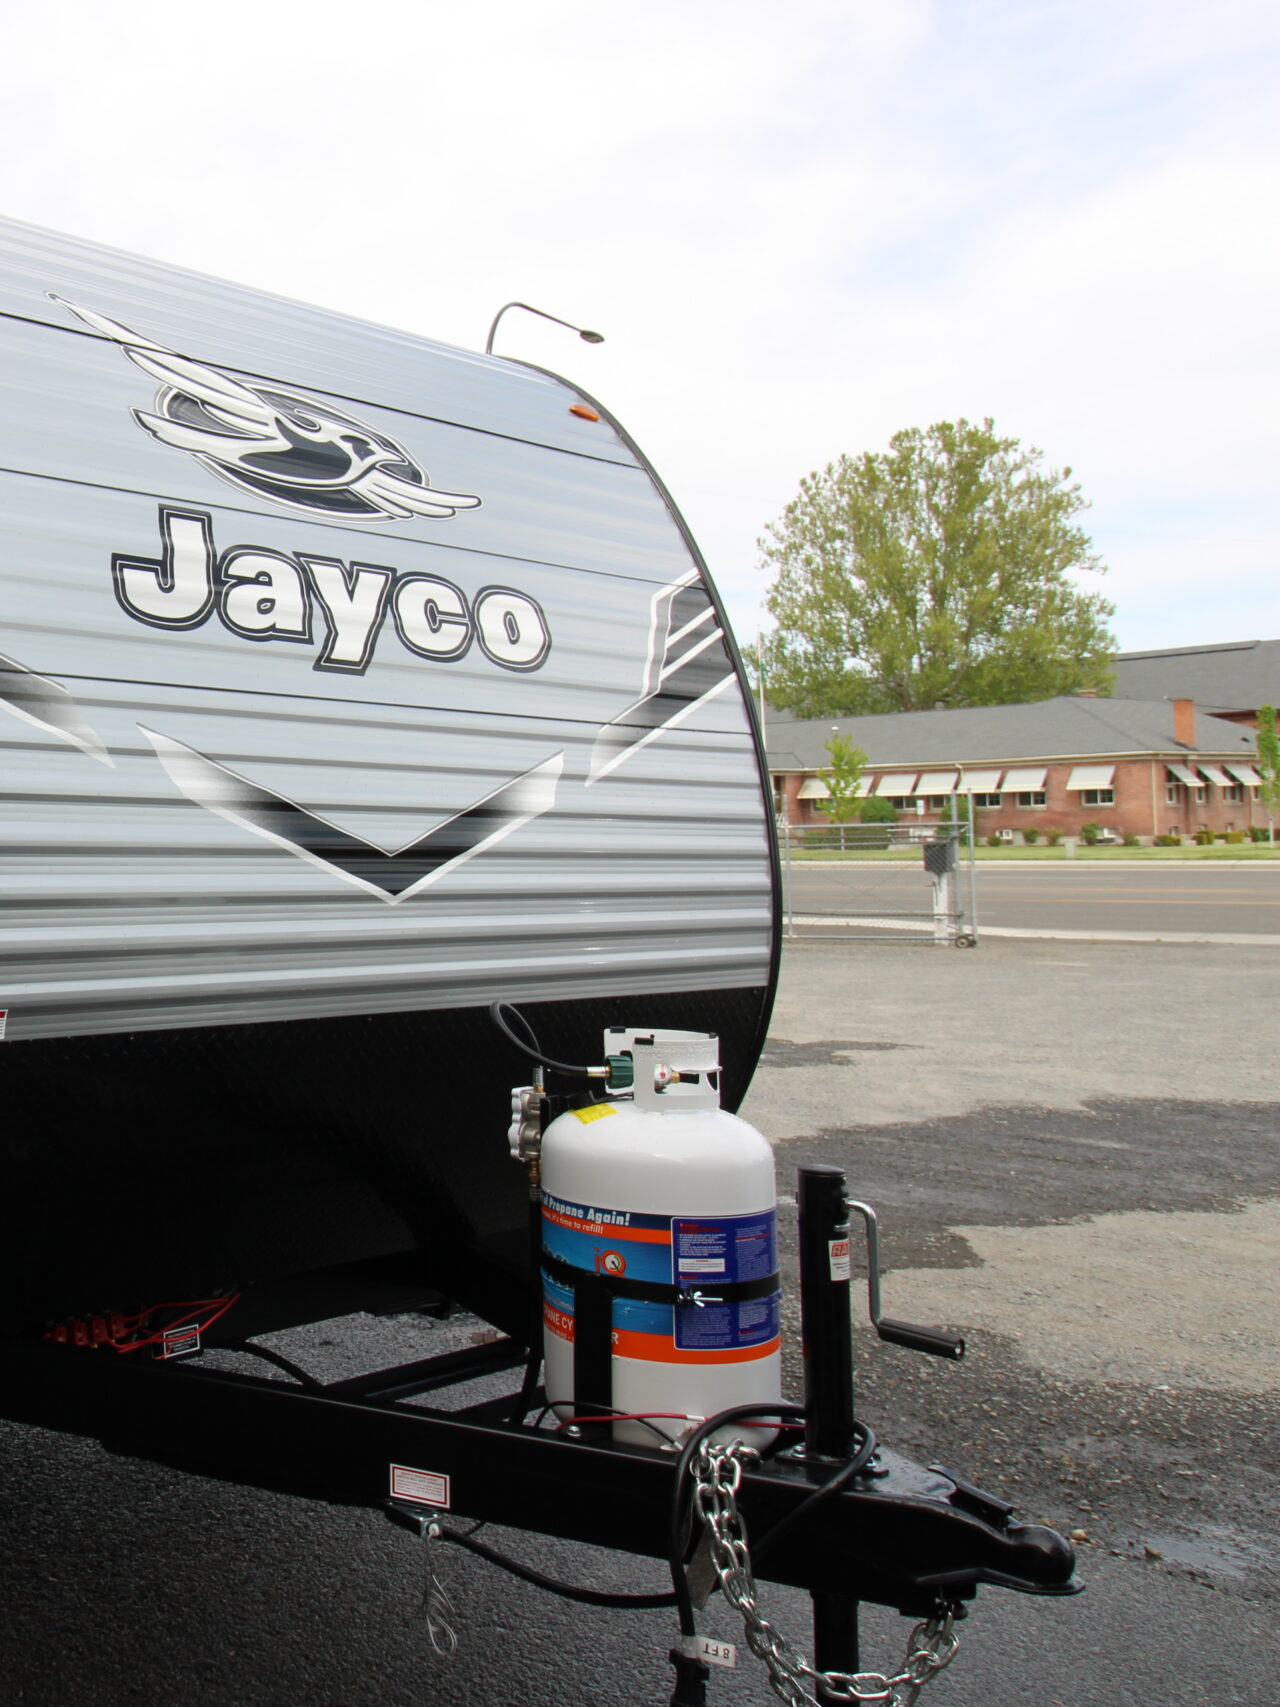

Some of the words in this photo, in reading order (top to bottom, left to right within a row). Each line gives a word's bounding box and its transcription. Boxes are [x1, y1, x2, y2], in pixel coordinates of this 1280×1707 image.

[111, 504, 552, 676] Jayco
[549, 1197, 584, 1218] Propane
[586, 1207, 631, 1226] Again!
[582, 1223, 604, 1234] refill!
[703, 1643, 719, 1656] FT
[723, 1647, 730, 1659] 8
